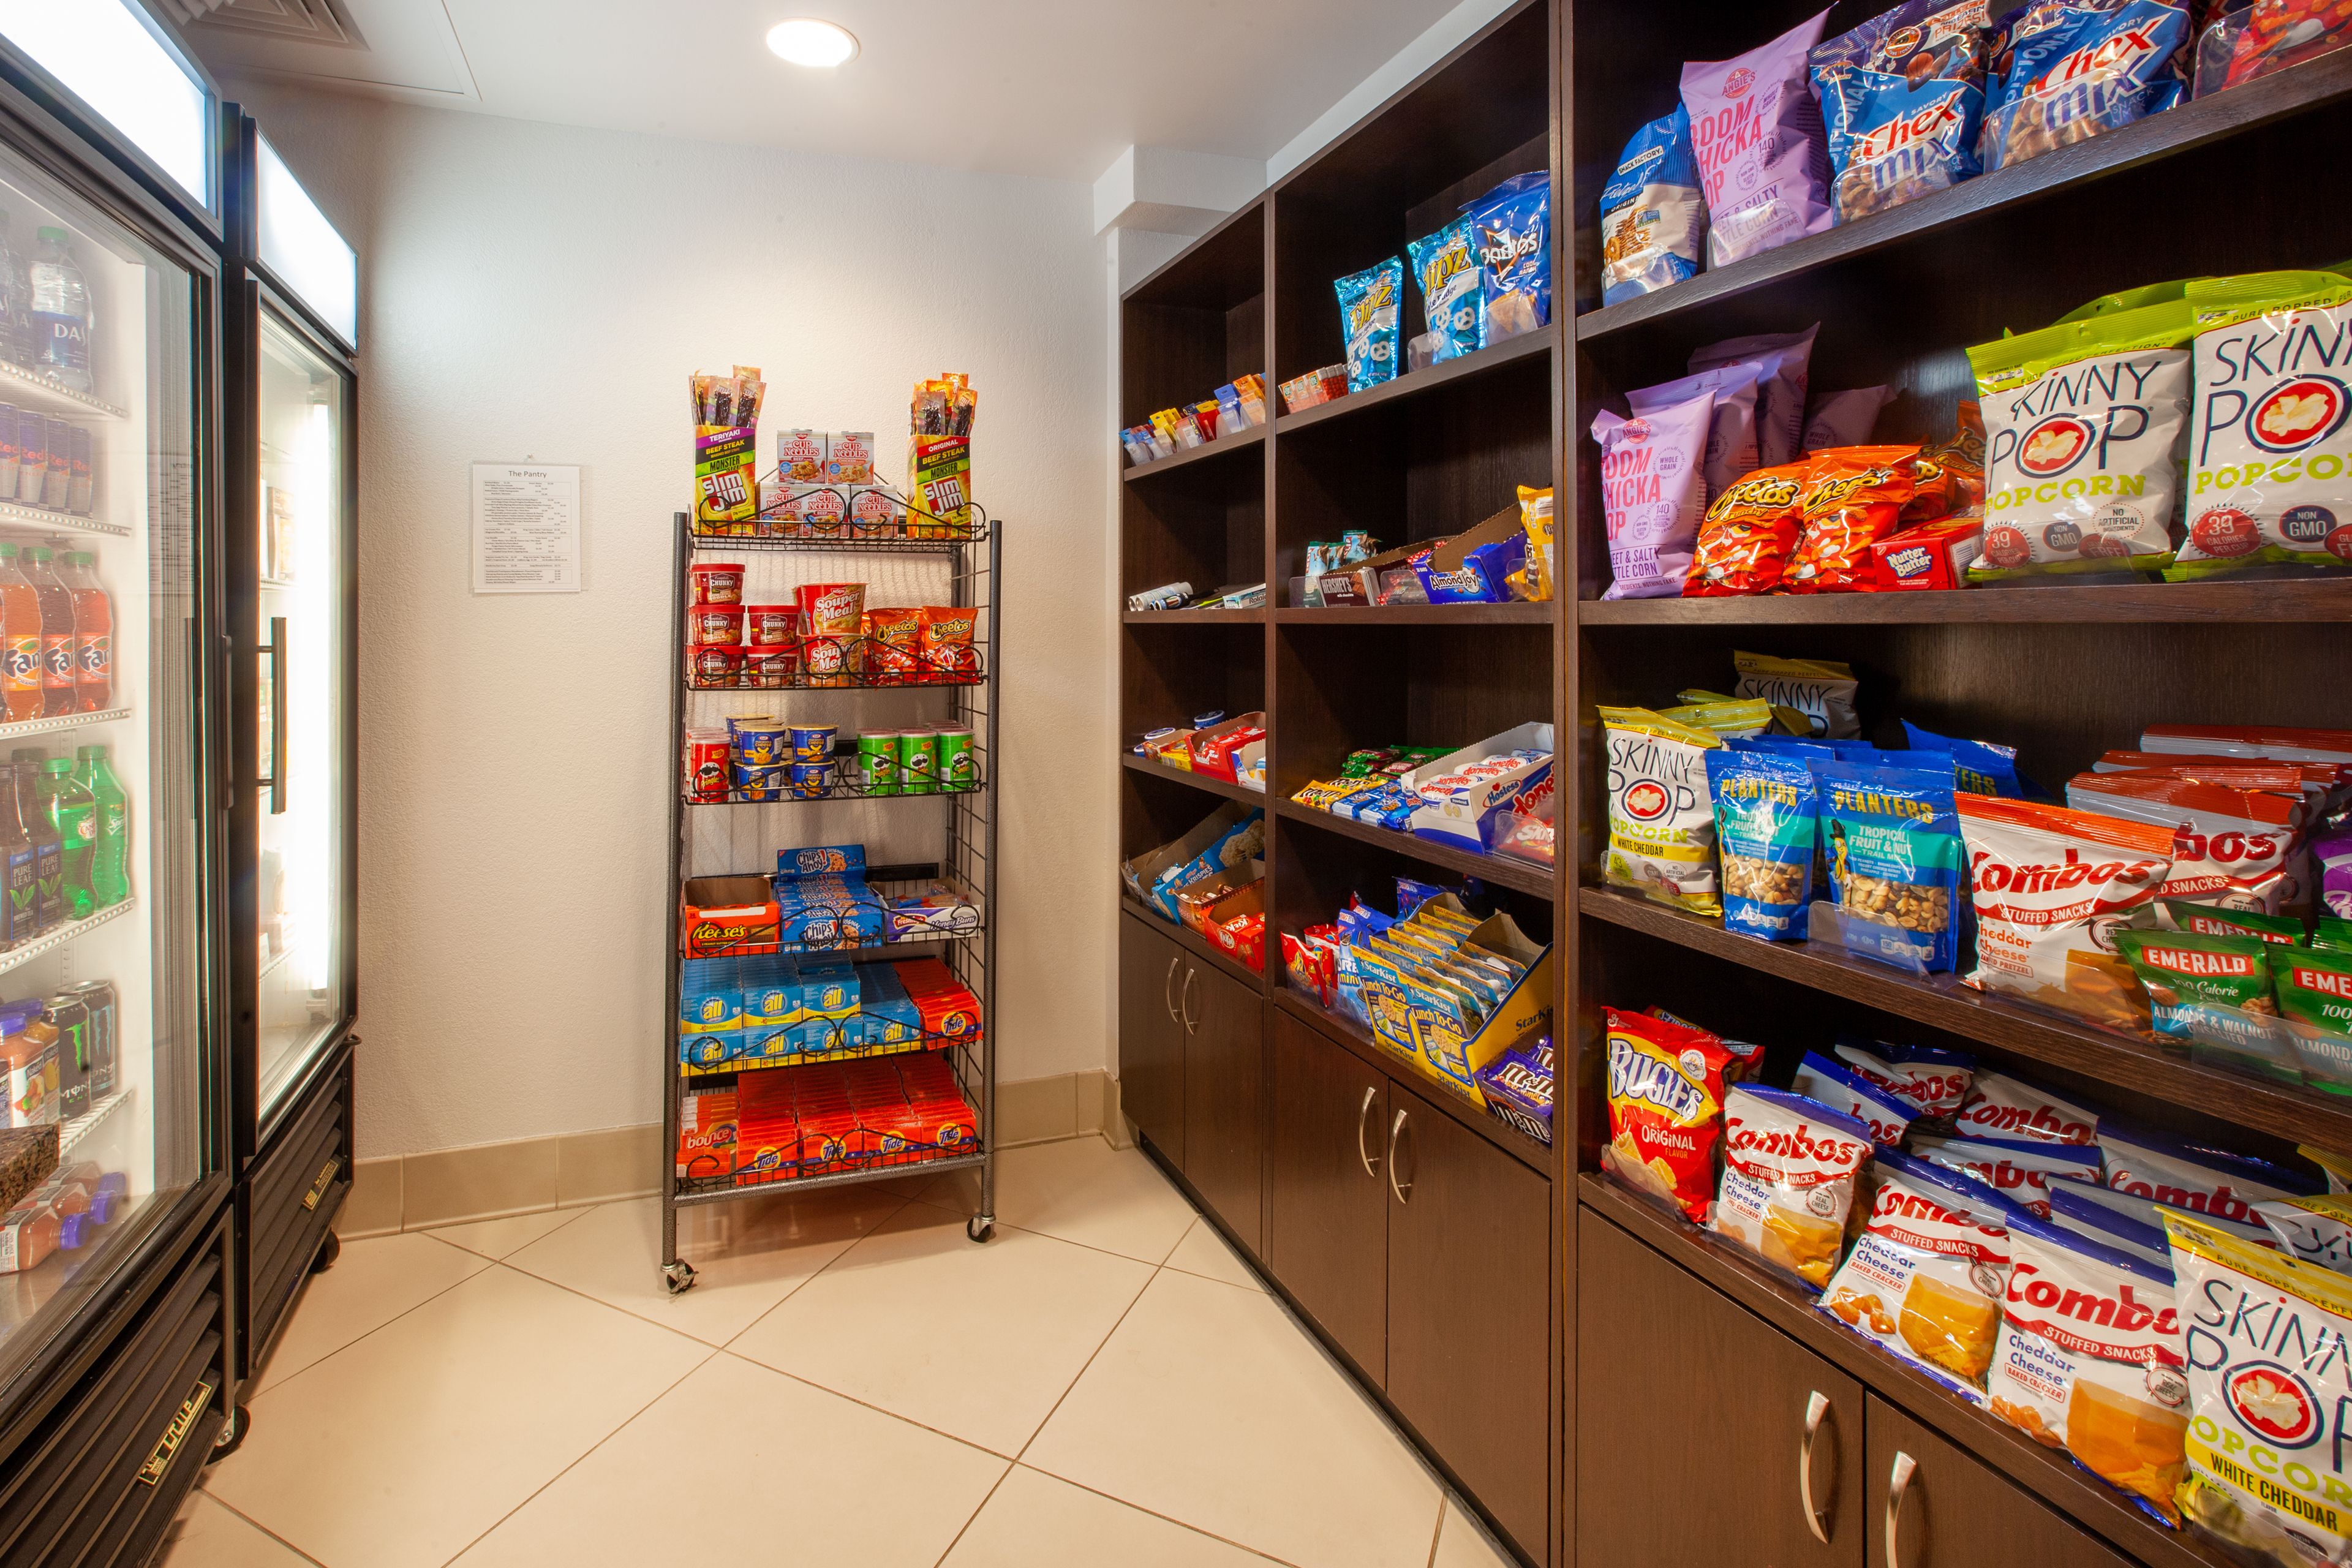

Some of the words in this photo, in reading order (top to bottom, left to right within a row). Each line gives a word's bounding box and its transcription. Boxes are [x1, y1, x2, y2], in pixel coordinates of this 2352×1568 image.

[2035, 19, 2162, 98] Chex
[1722, 72, 1756, 96] ANGIE'S
[1911, 92, 1947, 115] SAVORY
[1863, 91, 1961, 159] Chex
[1699, 115, 1762, 179] HICKA
[1758, 138, 1775, 153] 140
[1618, 160, 1634, 175] SNACK
[1634, 148, 1662, 168] FACTORY
[1480, 232, 1539, 264] Doritos
[2233, 308, 2263, 323] PURE
[2272, 298, 2332, 312] POPPED
[709, 429, 741, 442] TERIYAKI
[1623, 424, 1651, 438] ANGIE'S
[706, 444, 723, 455] BEEF
[723, 440, 745, 450] STEAK
[784, 448, 820, 457] NOODLES
[792, 440, 813, 449] CUP
[834, 448, 869, 458] NOODLES
[842, 442, 862, 451] CUP
[928, 439, 959, 453] ORIGINAL
[1987, 405, 2150, 494] POP
[710, 455, 741, 472] MONSTER
[922, 454, 941, 465] BEEF
[942, 447, 965, 459] STEAK
[1660, 456, 1679, 464] WHOLE
[930, 462, 958, 480] MONSTER
[808, 501, 843, 511] NOODLES
[816, 494, 837, 503] CUP
[858, 502, 892, 512] NOODLES
[865, 496, 886, 504] CUP
[1707, 477, 1801, 522] Cheetos
[2098, 517, 2139, 526] ARTIFICIAL
[2297, 511, 2317, 520] NON
[2208, 516, 2235, 535] 39
[2289, 519, 2328, 538] GMO
[1991, 531, 2011, 548] 39
[2051, 531, 2078, 547] GMO
[2206, 534, 2246, 547] CALORIES
[2214, 543, 2231, 554] PER
[1634, 547, 1661, 562] SALTY
[1889, 548, 1926, 567] Nutter
[1634, 562, 1658, 576] CORN
[1897, 557, 1932, 578] Butter
[1321, 577, 1352, 594] HERSHEY'S
[1430, 575, 1463, 590] Almond
[1463, 571, 1478, 587] Joy
[1643, 579, 1662, 588] NOTHING
[815, 591, 860, 612] Souper
[823, 603, 854, 622] Meal
[875, 620, 918, 644] Cheetos
[930, 619, 971, 641] Cheetos
[1743, 678, 1833, 712] SKINNY
[1611, 738, 1694, 784] SKINNY
[1487, 780, 1520, 807] Hostess
[1720, 778, 1798, 807] PLANTERS
[1834, 790, 1934, 824] PLANTERS
[1858, 824, 1907, 844] TROPICAL
[1617, 837, 1634, 853] WHITE
[1634, 840, 1664, 858] CHEDDAR
[1849, 835, 1882, 850] FRUIT
[1893, 842, 1913, 856] NUT
[1861, 848, 1885, 860] TRAIL
[40, 854, 59, 867] PURE
[797, 850, 821, 866] Chips
[13, 863, 32, 876] PURE
[41, 864, 59, 877] LEAF
[1188, 864, 1214, 885] KRISPIES
[1971, 848, 2163, 894] Combos
[14, 875, 32, 888] LEAF
[2172, 876, 2226, 894] SNACKS
[2000, 907, 2049, 923] STUFFED
[2051, 900, 2095, 922] SNACKS
[929, 918, 956, 931] Honey
[956, 914, 976, 926] Buns
[1980, 939, 2029, 963] Cheese
[2000, 960, 2030, 974] PRETZEL
[2148, 948, 2247, 974] EMERALD
[1339, 973, 1359, 986] mini
[1365, 960, 1397, 984] StarKist
[823, 988, 843, 1007] all
[1381, 981, 1406, 1003] To-Go
[2196, 981, 2239, 997] Calorie
[703, 999, 723, 1020] all
[764, 993, 785, 1013] all
[1416, 988, 1452, 1013] StarKist
[1412, 1006, 1435, 1023] Lunch
[1435, 1012, 1463, 1034] To-Go
[2154, 1006, 2206, 1025] ALMONDS
[1385, 1039, 1415, 1061] StarKist
[1436, 1071, 1471, 1098] StarKist
[687, 1128, 731, 1150] bounce
[882, 1139, 903, 1152] Tide
[1725, 1117, 1861, 1166] Combos
[756, 1155, 778, 1169] Tide
[1665, 1147, 1689, 1159] FLAVOR
[1725, 1171, 1770, 1201] Cheddar
[1725, 1185, 1762, 1210] Cheese
[1811, 1199, 1830, 1212] CHEESE
[1815, 1195, 1828, 1205] REAL
[1736, 1202, 1760, 1221] CRACKER
[1890, 1227, 1935, 1250] STUFFED
[1936, 1240, 1980, 1257] SNACKS
[1856, 1250, 1906, 1280] Cheese
[2217, 1254, 2249, 1275] PURE
[1850, 1261, 1872, 1276] BAKED
[1872, 1270, 1904, 1291] CRACKER
[2043, 1326, 2100, 1354] STUFFED
[2103, 1345, 2157, 1361] SNACKS
[2009, 1333, 2076, 1374] Cheddar
[2010, 1351, 2065, 1386] Cheese
[2008, 1366, 2028, 1384] BAKED
[2029, 1375, 2063, 1401] CRACKER
[2210, 1451, 2255, 1493] WHITE
[2260, 1479, 2339, 1532] CHEDDAR
